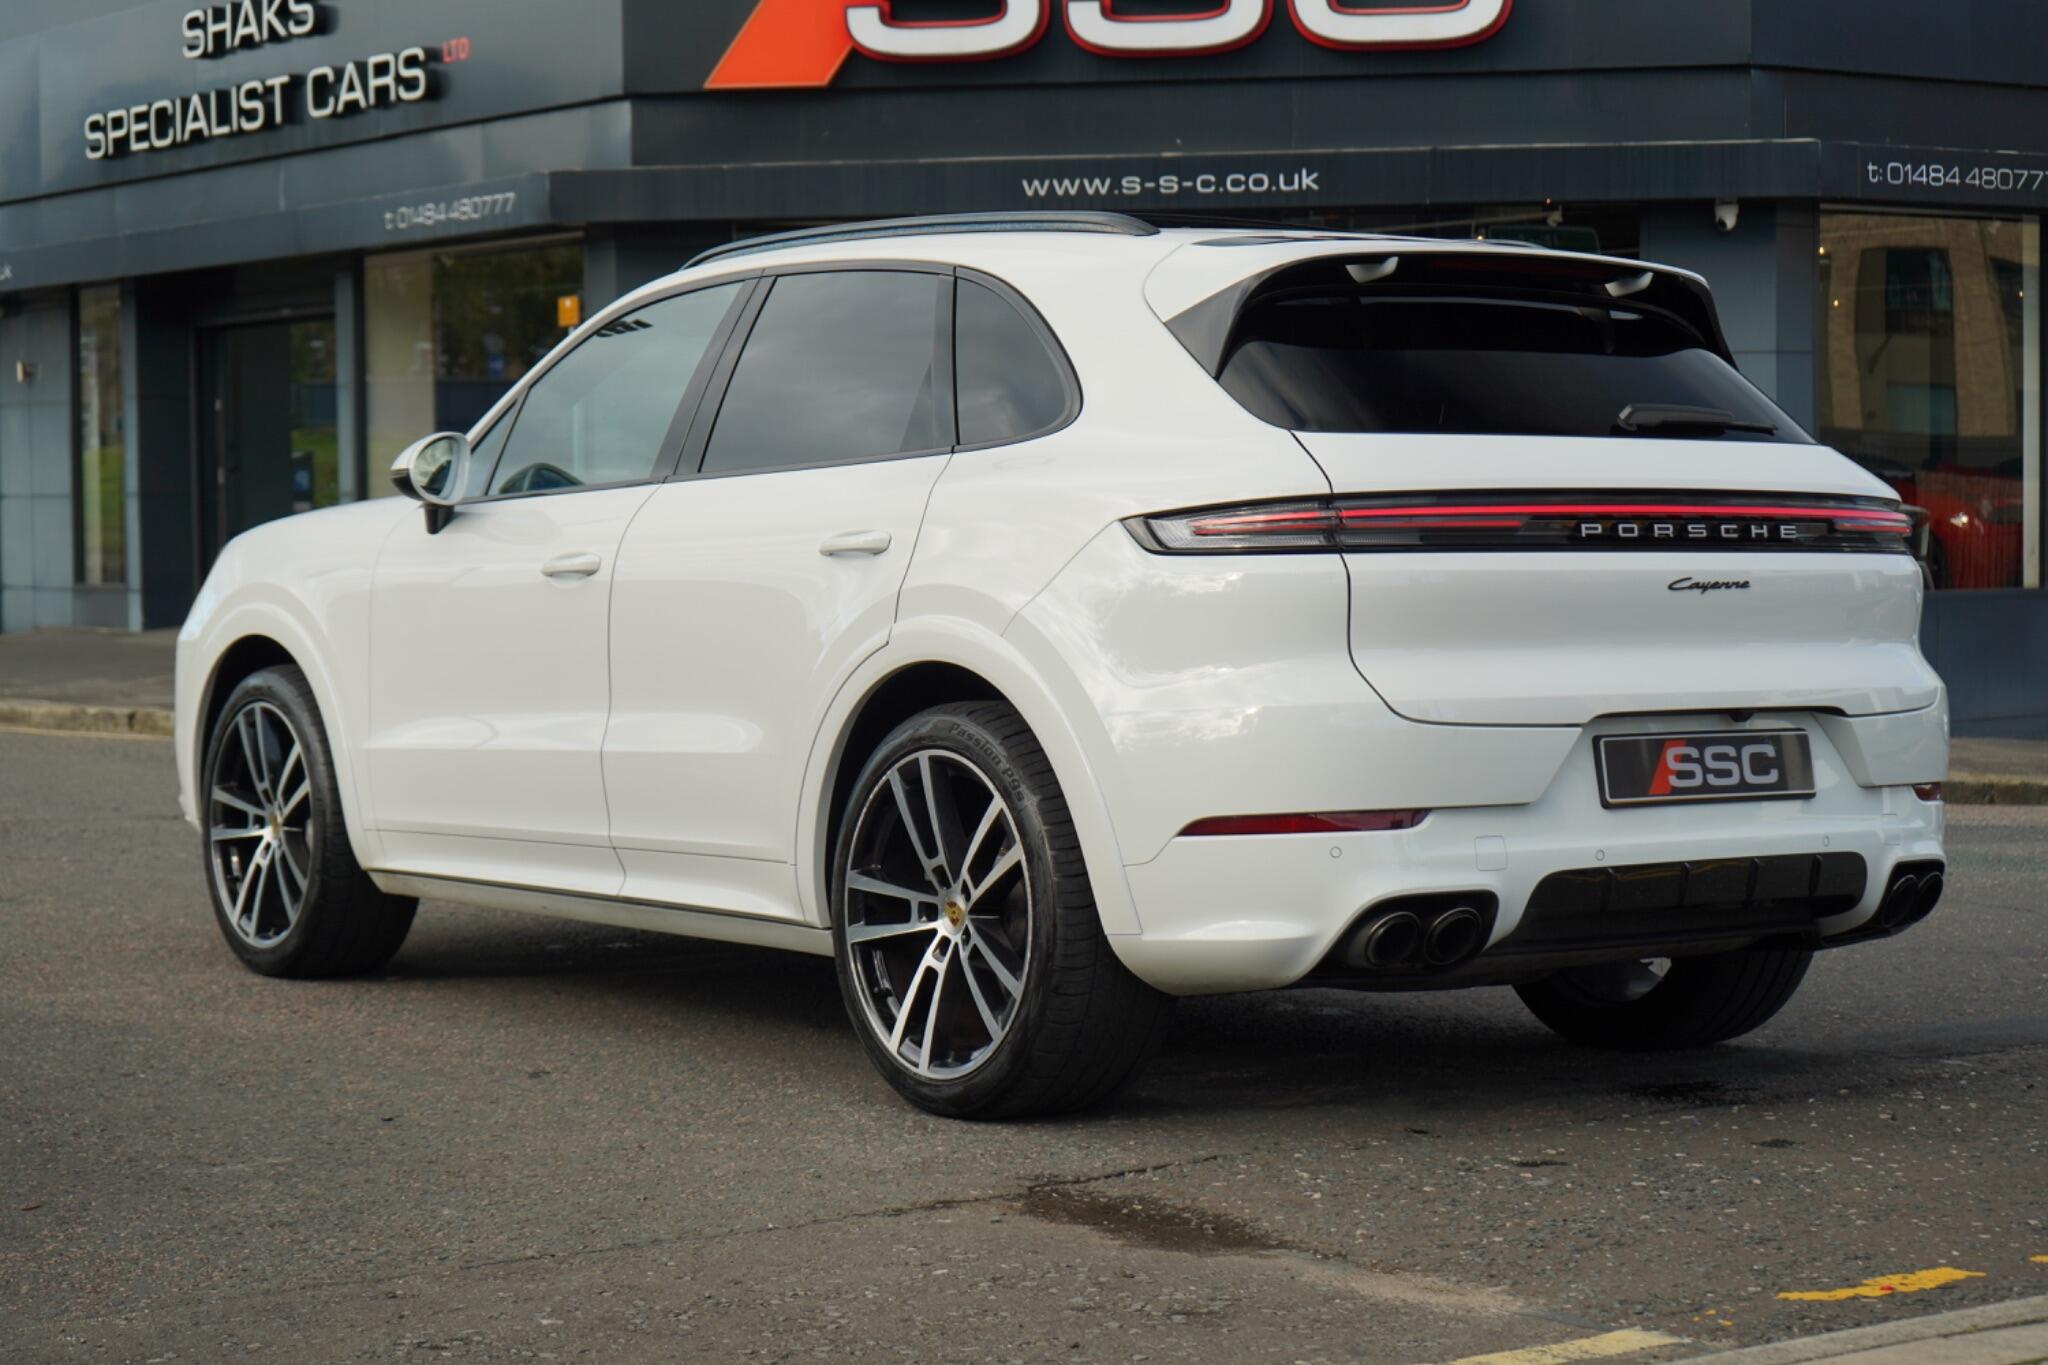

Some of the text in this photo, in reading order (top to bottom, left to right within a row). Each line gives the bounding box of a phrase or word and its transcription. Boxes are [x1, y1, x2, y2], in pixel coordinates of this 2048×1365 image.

[182, 0, 315, 59] SHAKS
[84, 37, 470, 160] SPECIALIST CARS LTD
[1021, 168, 1320, 198] www.s-s-c.co.uk
[1965, 166, 2048, 190] 48077
[1580, 523, 1798, 539] PORSCHE
[1667, 576, 1751, 595] Cayenne
[1665, 743, 1780, 788] SSC
